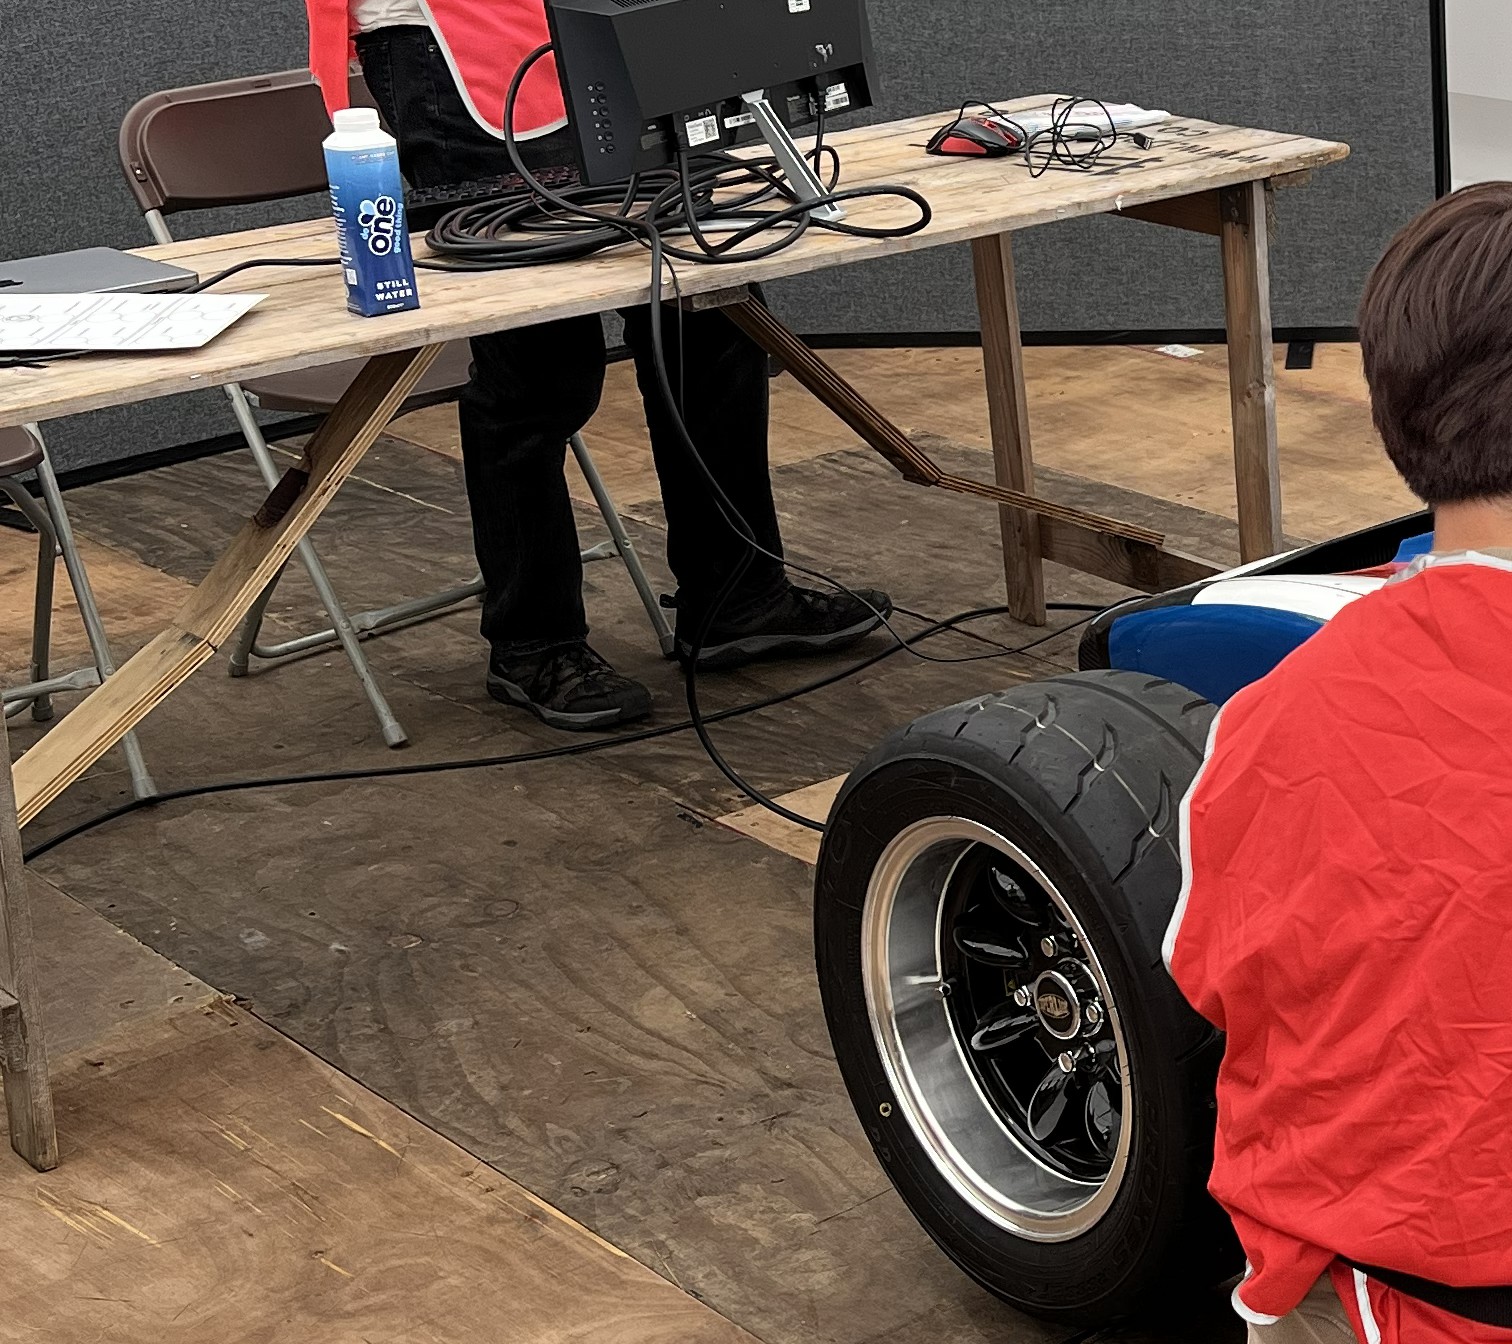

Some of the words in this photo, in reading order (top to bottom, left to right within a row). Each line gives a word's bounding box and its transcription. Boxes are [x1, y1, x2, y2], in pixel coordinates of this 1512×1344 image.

[368, 196, 396, 255] one
[376, 279, 409, 290] STILL
[375, 288, 412, 301] WATER
